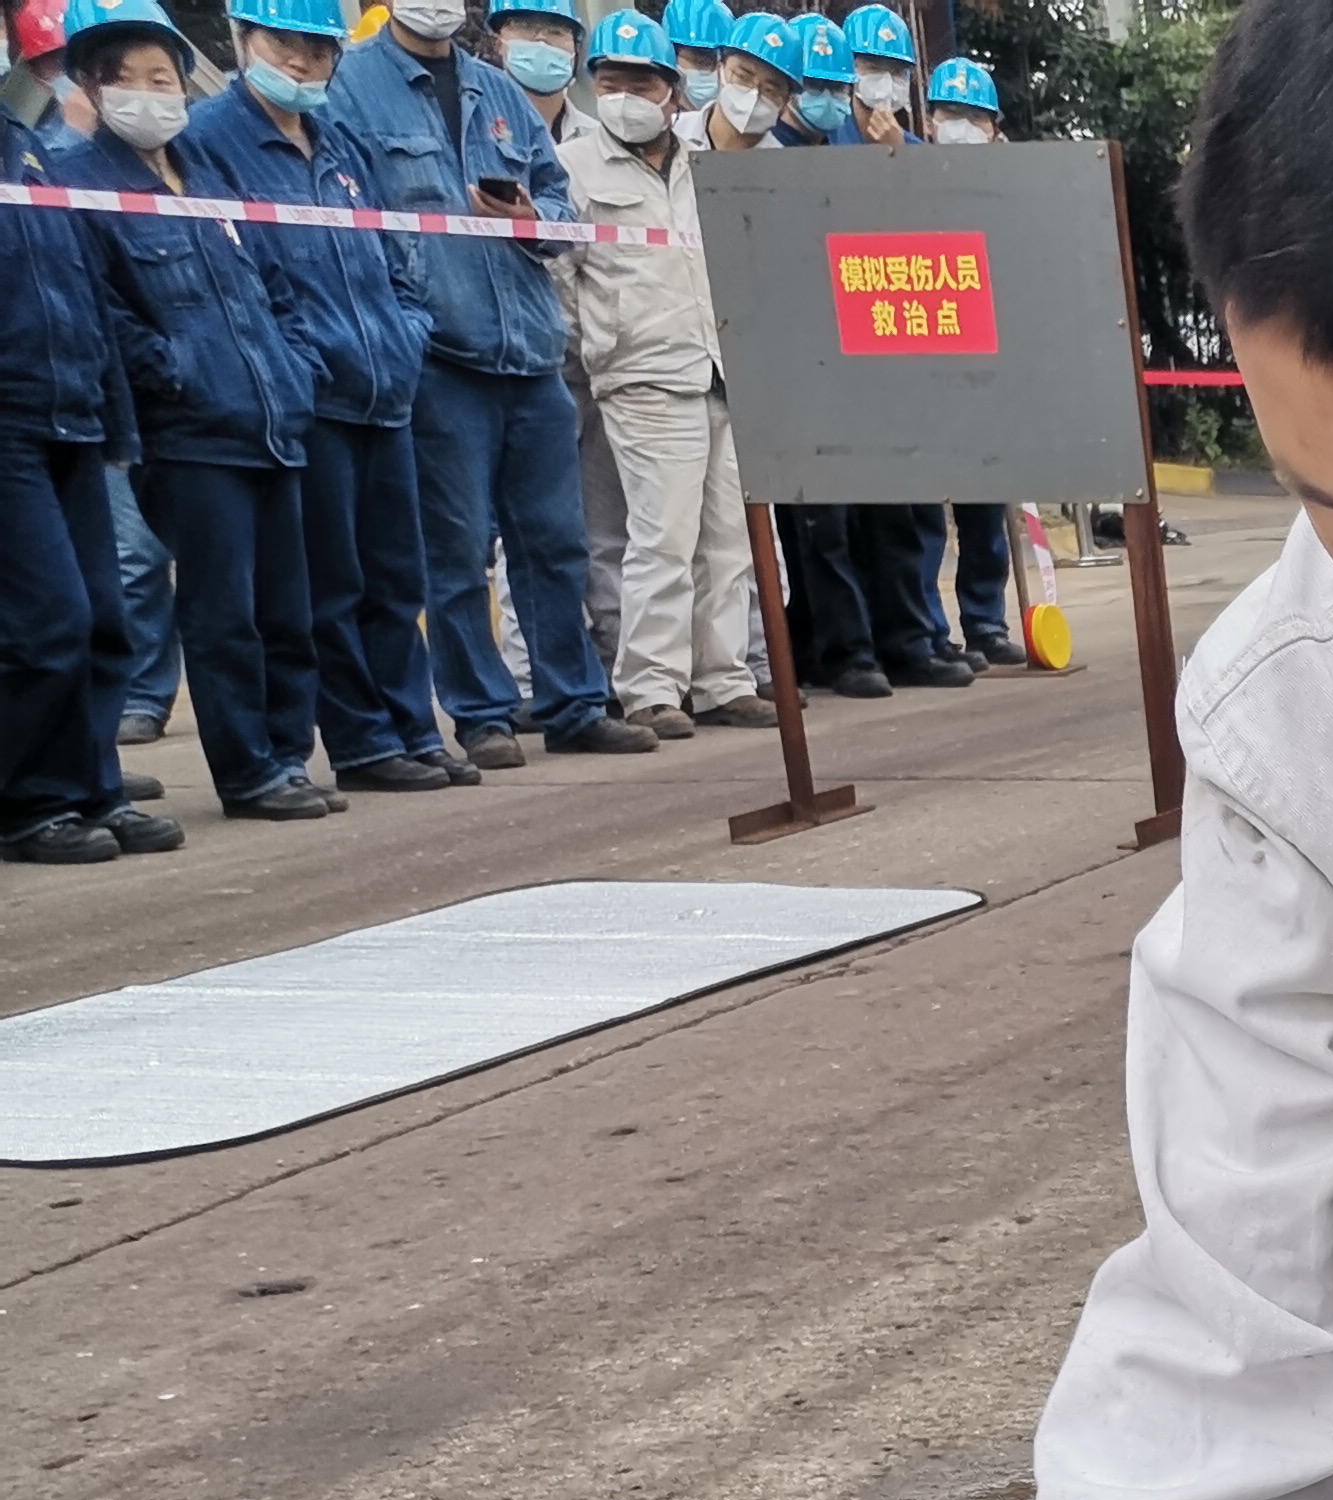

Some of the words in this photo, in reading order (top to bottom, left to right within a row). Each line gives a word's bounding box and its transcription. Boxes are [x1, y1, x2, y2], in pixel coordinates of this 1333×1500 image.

[839, 254, 981, 292] 模拟受伤人员
[871, 299, 961, 337] 救治点
